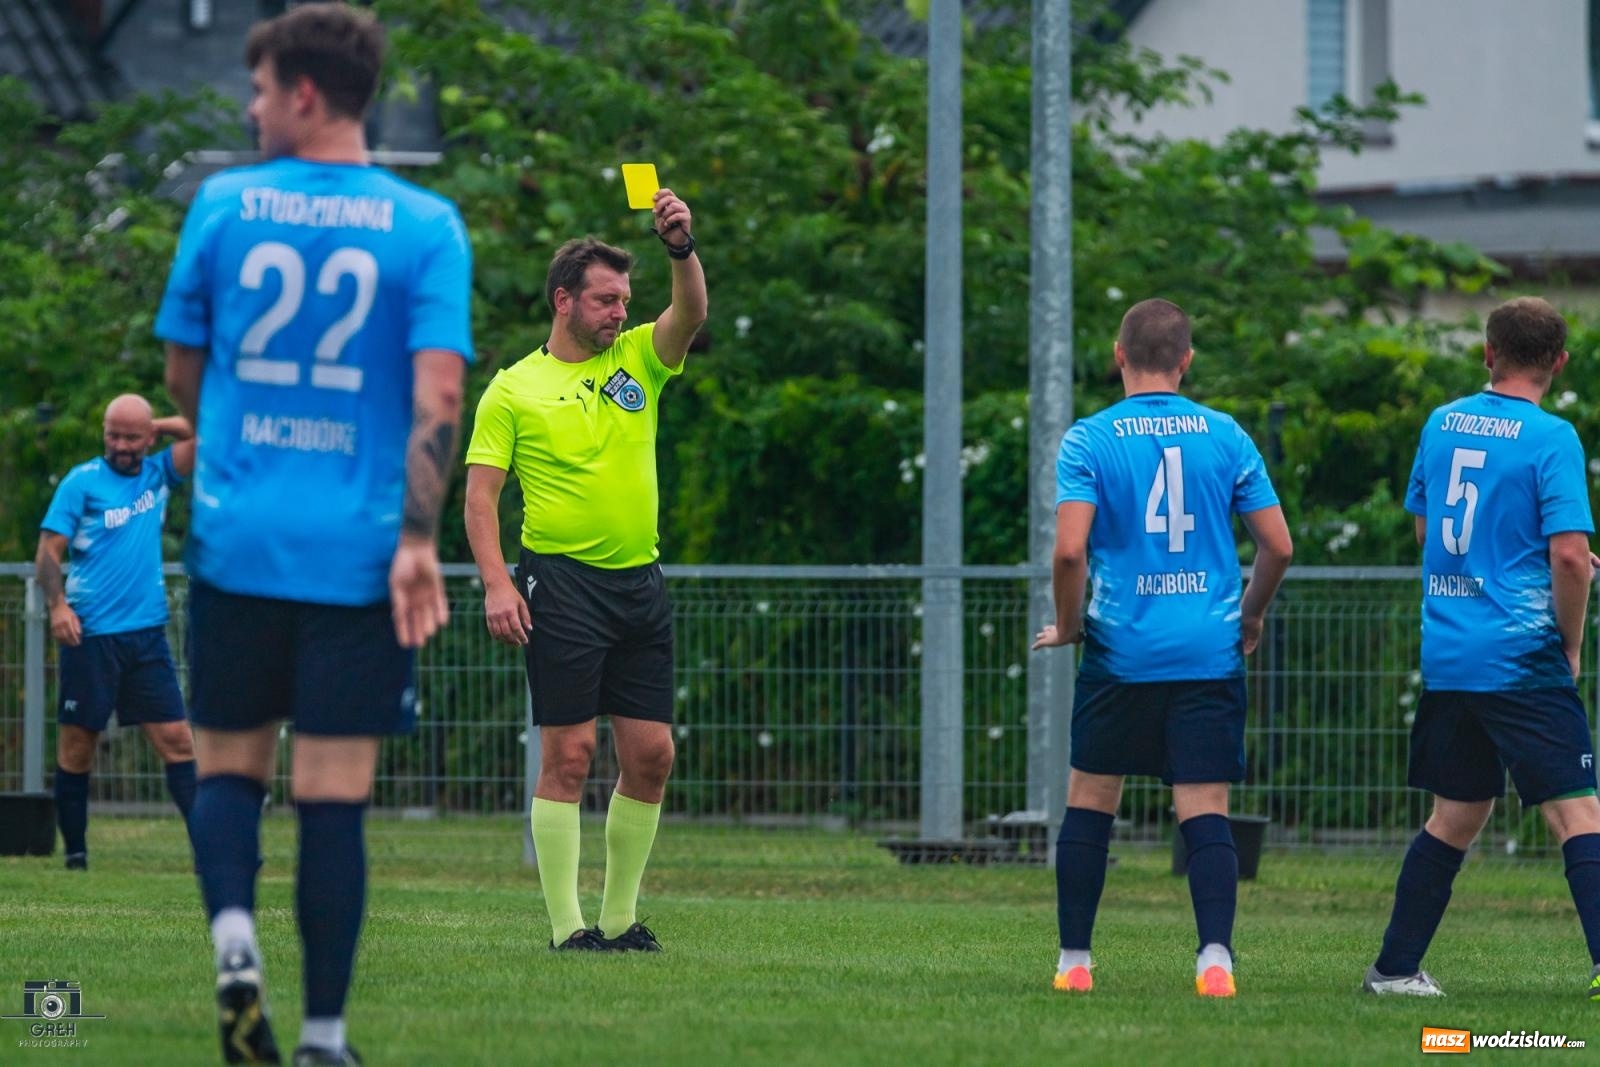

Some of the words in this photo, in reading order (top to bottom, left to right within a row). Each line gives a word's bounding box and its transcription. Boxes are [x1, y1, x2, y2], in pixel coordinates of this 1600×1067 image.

[236, 241, 378, 392] 22
[1113, 415, 1208, 437] STUDZIENNA
[1441, 412, 1523, 440] STUDZIENNA
[1145, 446, 1194, 552] 4
[1442, 448, 1487, 556] 5
[1136, 569, 1207, 595] RACIBÓRZ
